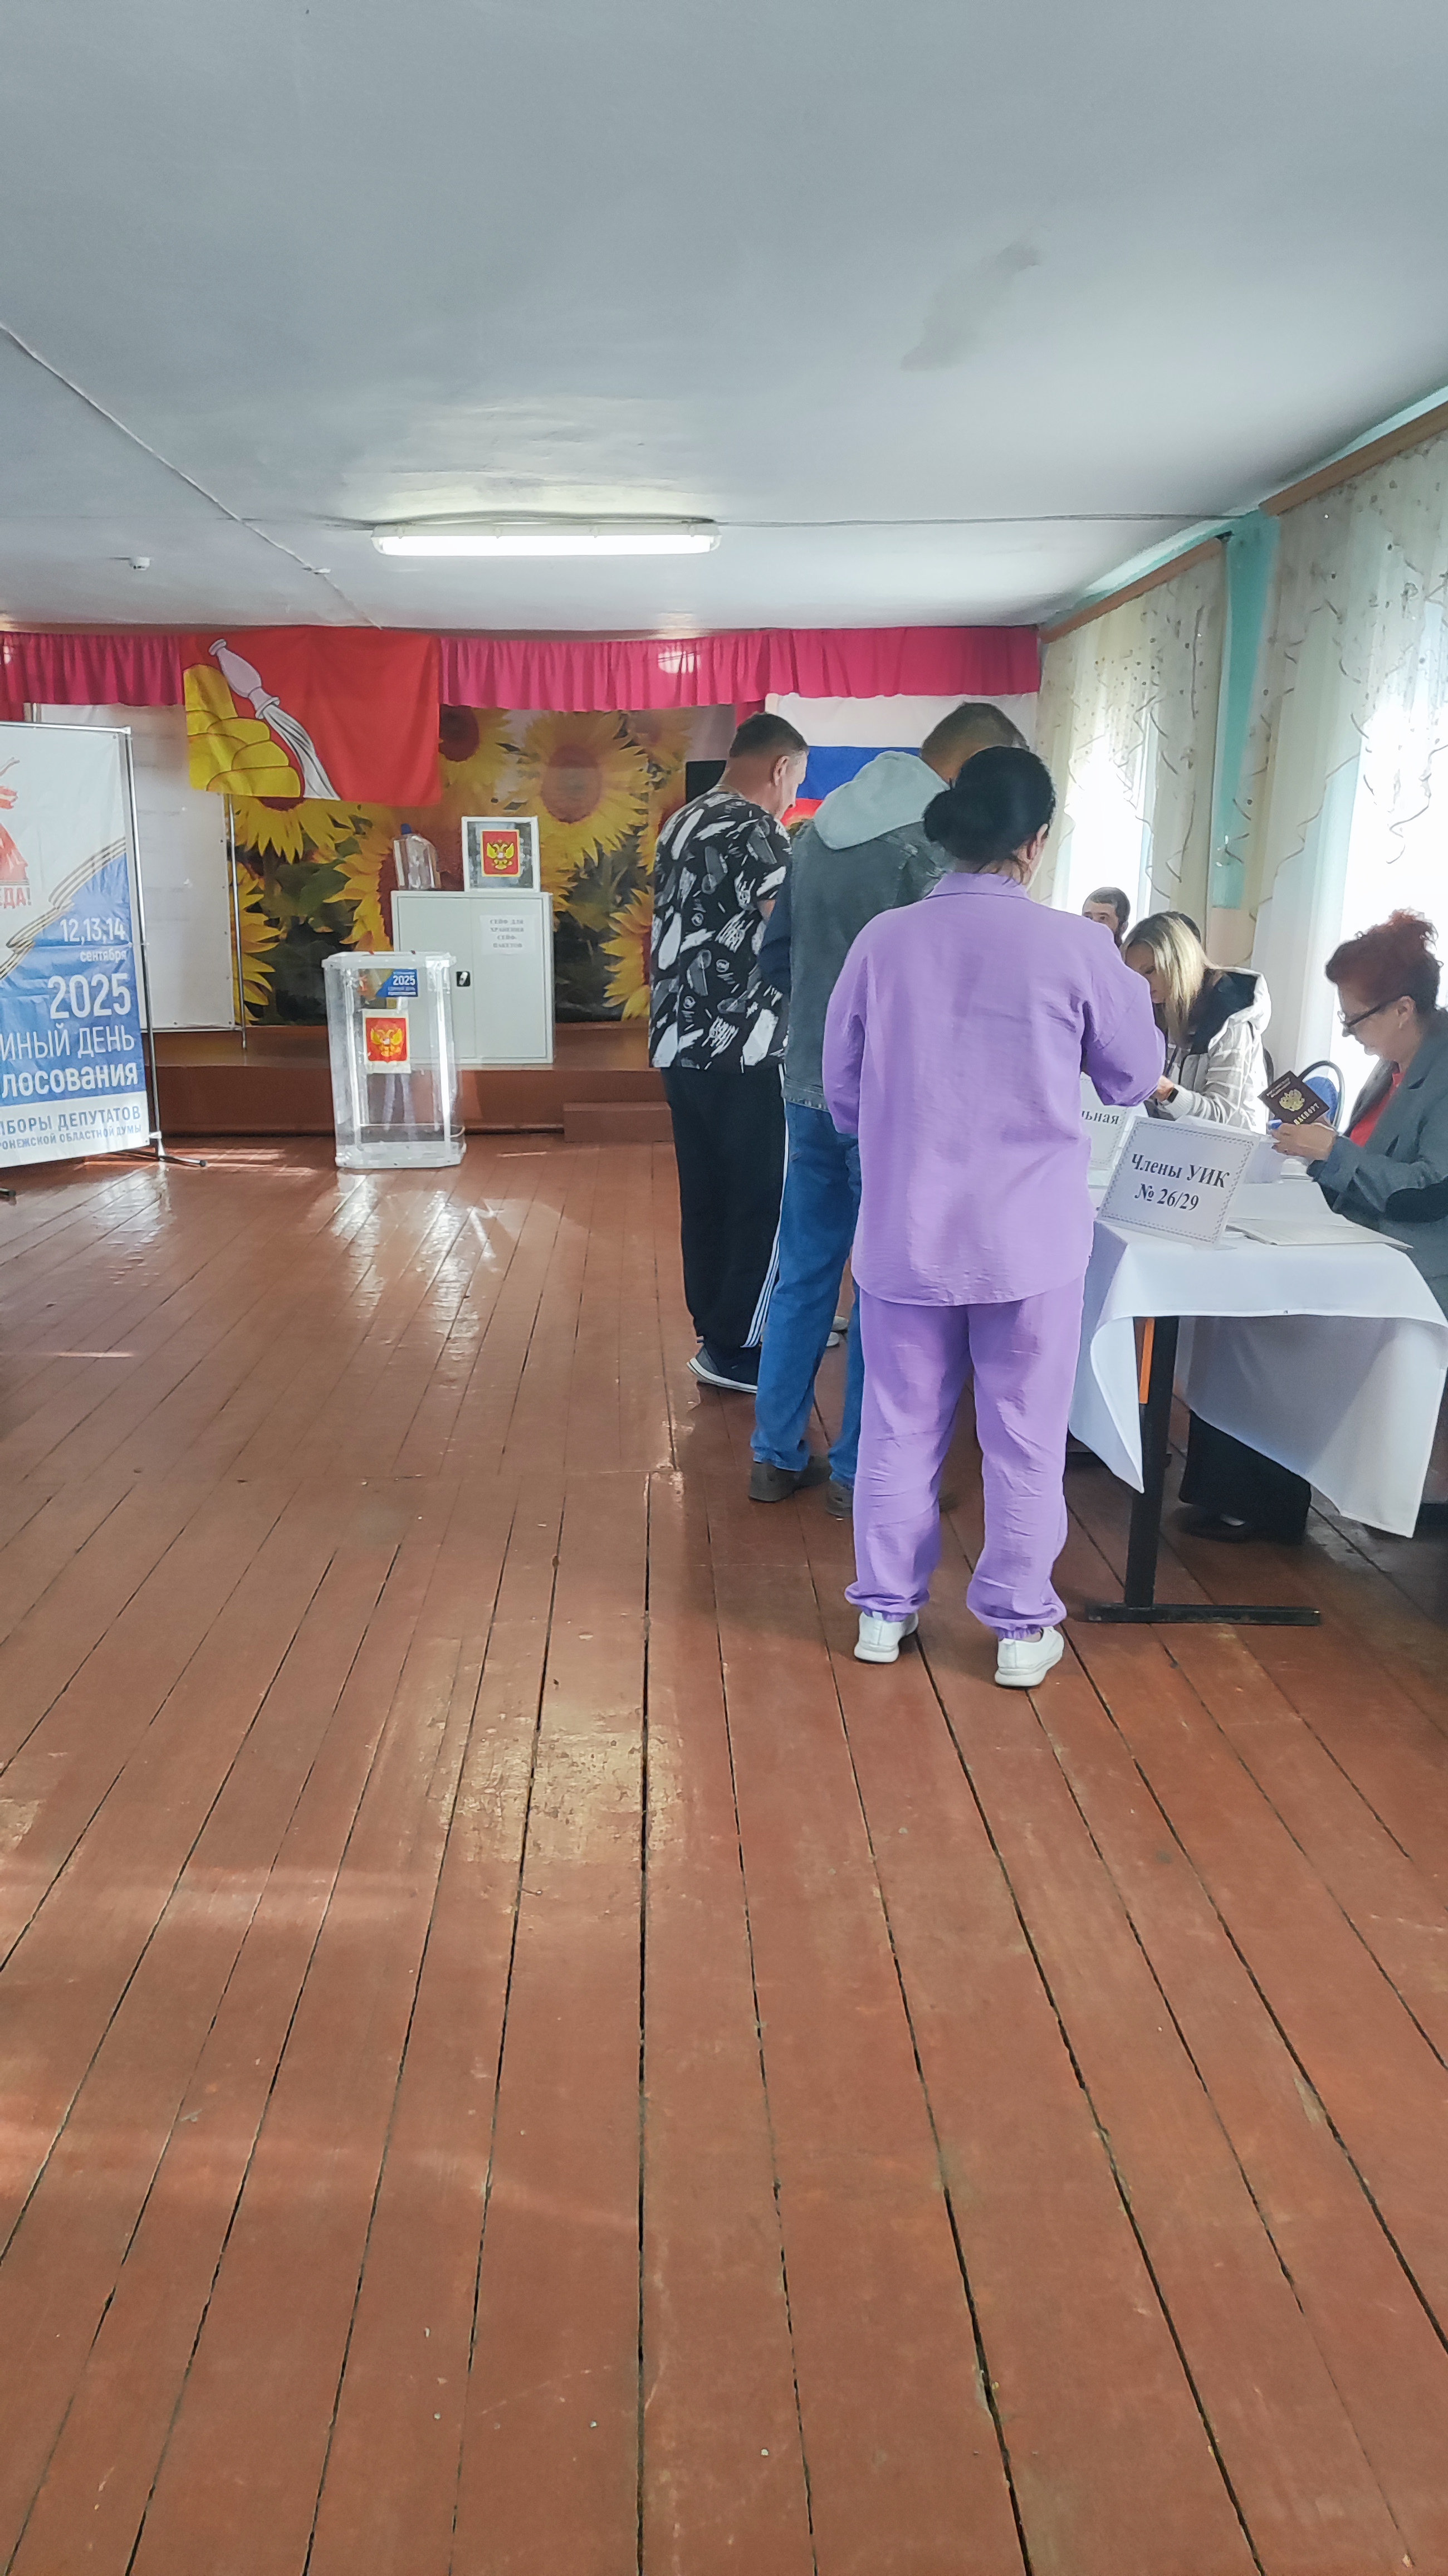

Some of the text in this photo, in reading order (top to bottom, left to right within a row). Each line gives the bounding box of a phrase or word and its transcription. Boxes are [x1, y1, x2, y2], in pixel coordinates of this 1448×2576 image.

[0, 887, 31, 909] ДА!
[60, 918, 125, 946] 12,13,14
[80, 948, 127, 963] сентября
[393, 975, 415, 985] 2025
[48, 972, 131, 1019] 2025
[77, 1025, 135, 1059] ДЕНЬ
[2, 1062, 139, 1099] лосования
[58, 1106, 141, 1131] ДЕПУТАТОВ
[0, 1124, 142, 1150] ОНЕЖСКОЙ ОБЛАСТНОЙ ДУМЫ
[1132, 1153, 1230, 1188] Члены УИК
[1134, 1183, 1200, 1211] № 26/29
